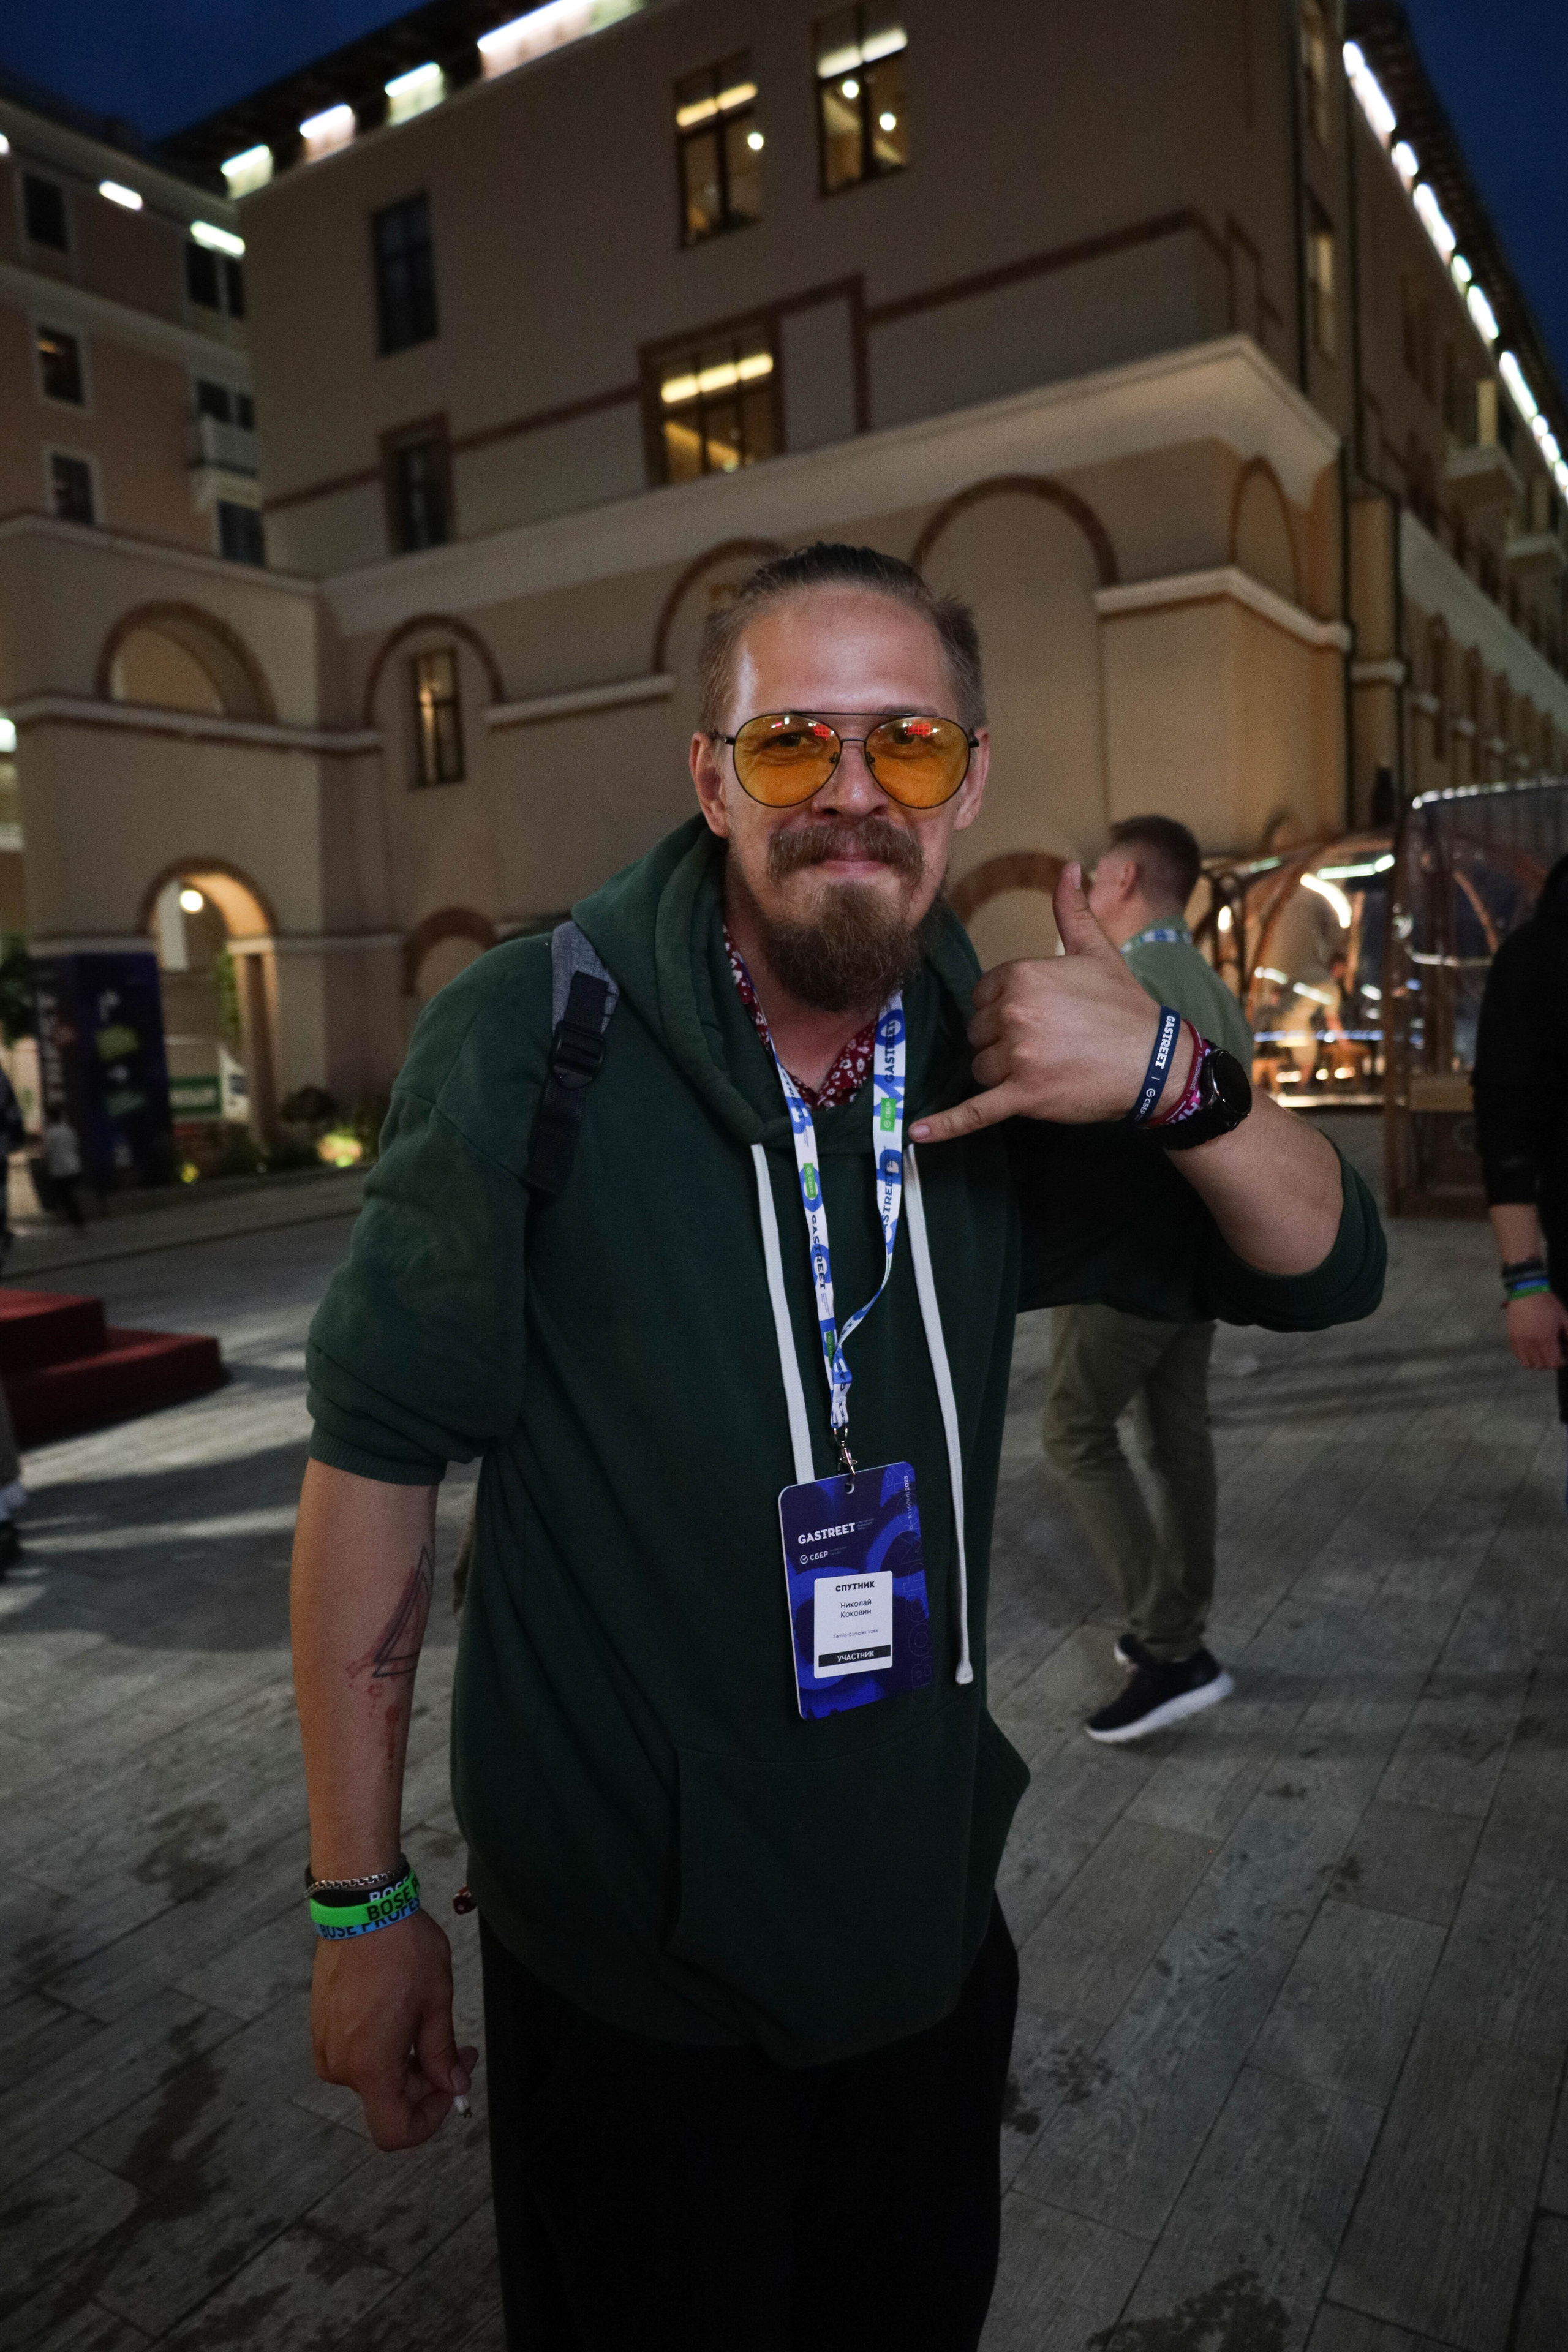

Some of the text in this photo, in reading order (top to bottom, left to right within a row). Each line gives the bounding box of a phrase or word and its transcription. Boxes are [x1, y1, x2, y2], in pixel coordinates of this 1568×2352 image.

[1155, 1015, 1175, 1069] GASTREET
[884, 1021, 895, 1084] GASTREET
[1139, 1098, 1151, 1115] СБЕР
[812, 1214, 826, 1290] GASTREET
[797, 1522, 856, 1545] GASTREET
[809, 1550, 829, 1561] СБЕР
[835, 1581, 875, 1592] СПУТНИК
[840, 1599, 872, 1608] Николай
[840, 1609, 872, 1618] Коковин
[837, 1650, 875, 1662] УЧАСТНИК
[367, 1885, 413, 1921] BOSE
